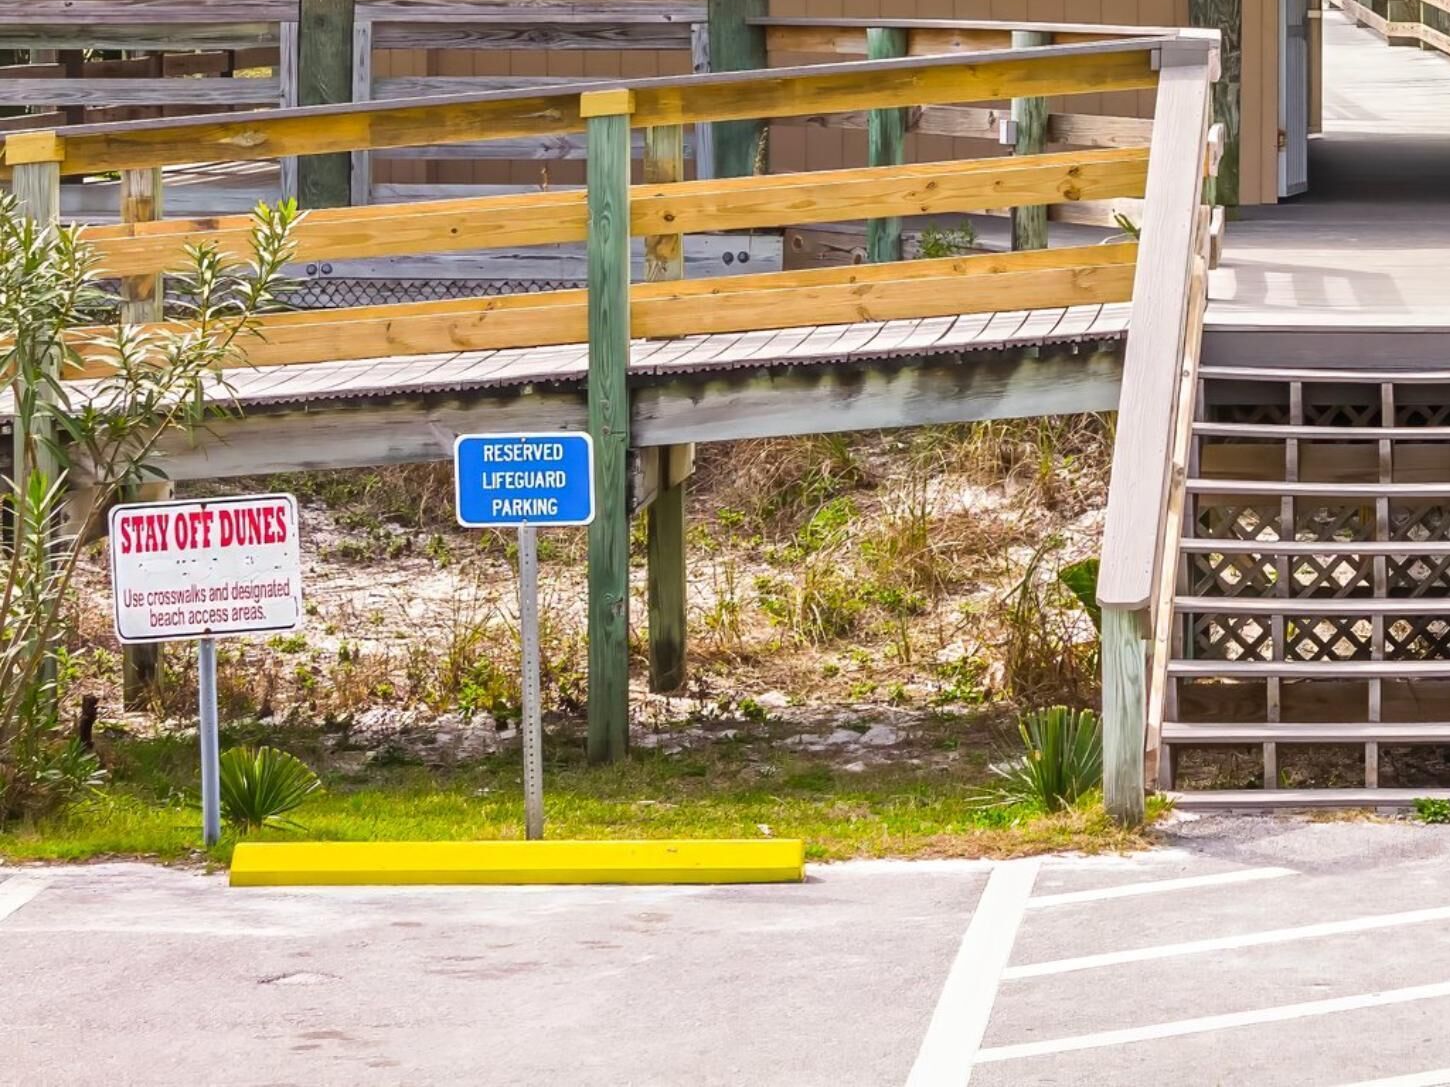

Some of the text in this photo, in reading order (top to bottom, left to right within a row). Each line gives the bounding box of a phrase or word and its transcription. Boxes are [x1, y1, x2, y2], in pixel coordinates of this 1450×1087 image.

[483, 444, 564, 462] RESERVED
[482, 470, 566, 489] LIFEGUARD
[492, 498, 558, 517] PARKING
[121, 506, 287, 554] STAY OFF DUNES
[123, 578, 290, 608] Use crosswalks and designated
[149, 606, 267, 627] beach access areas.
